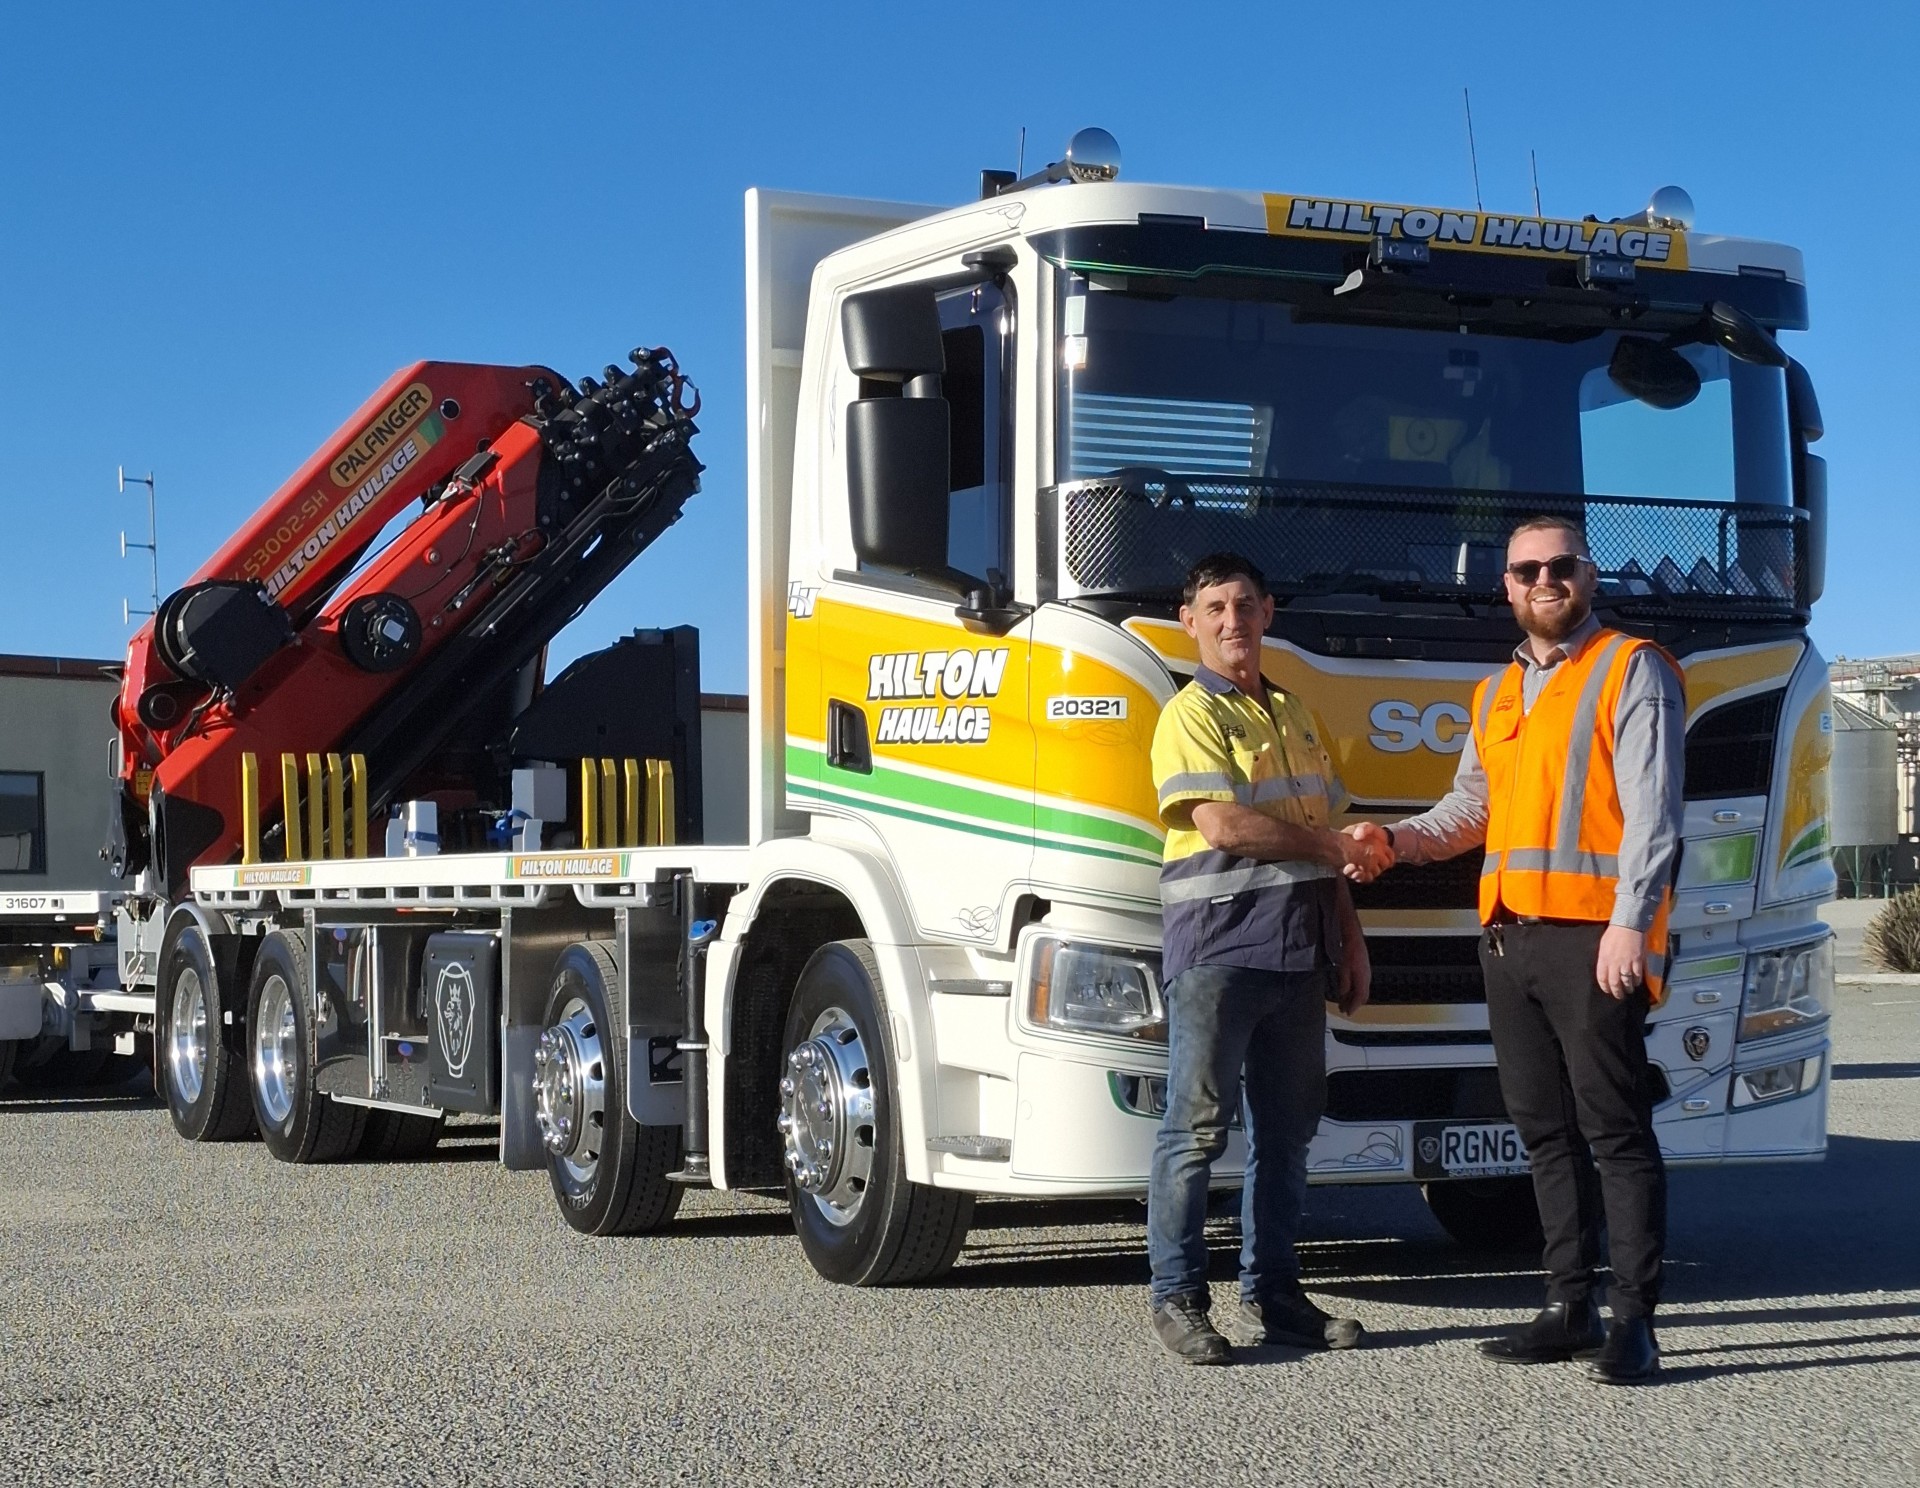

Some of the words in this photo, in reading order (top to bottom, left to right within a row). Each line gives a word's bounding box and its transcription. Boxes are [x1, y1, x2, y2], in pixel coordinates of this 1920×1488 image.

[1288, 198, 1477, 243] HILTON
[1484, 217, 1672, 261] HAULAGE
[335, 389, 428, 482] PALFINGER
[335, 438, 419, 530] HAULAGE
[243, 490, 329, 579] 53002-SH
[867, 649, 1009, 700] HILTON
[875, 706, 990, 744] HAULAGE
[1052, 699, 1122, 717] 20321
[244, 871, 269, 884] HILTON
[270, 869, 301, 883] HAULAGE
[521, 860, 562, 876] HILTON
[564, 858, 613, 875] HAULAGE
[6, 898, 46, 909] 31607
[1485, 1166, 1506, 1176] NEW
